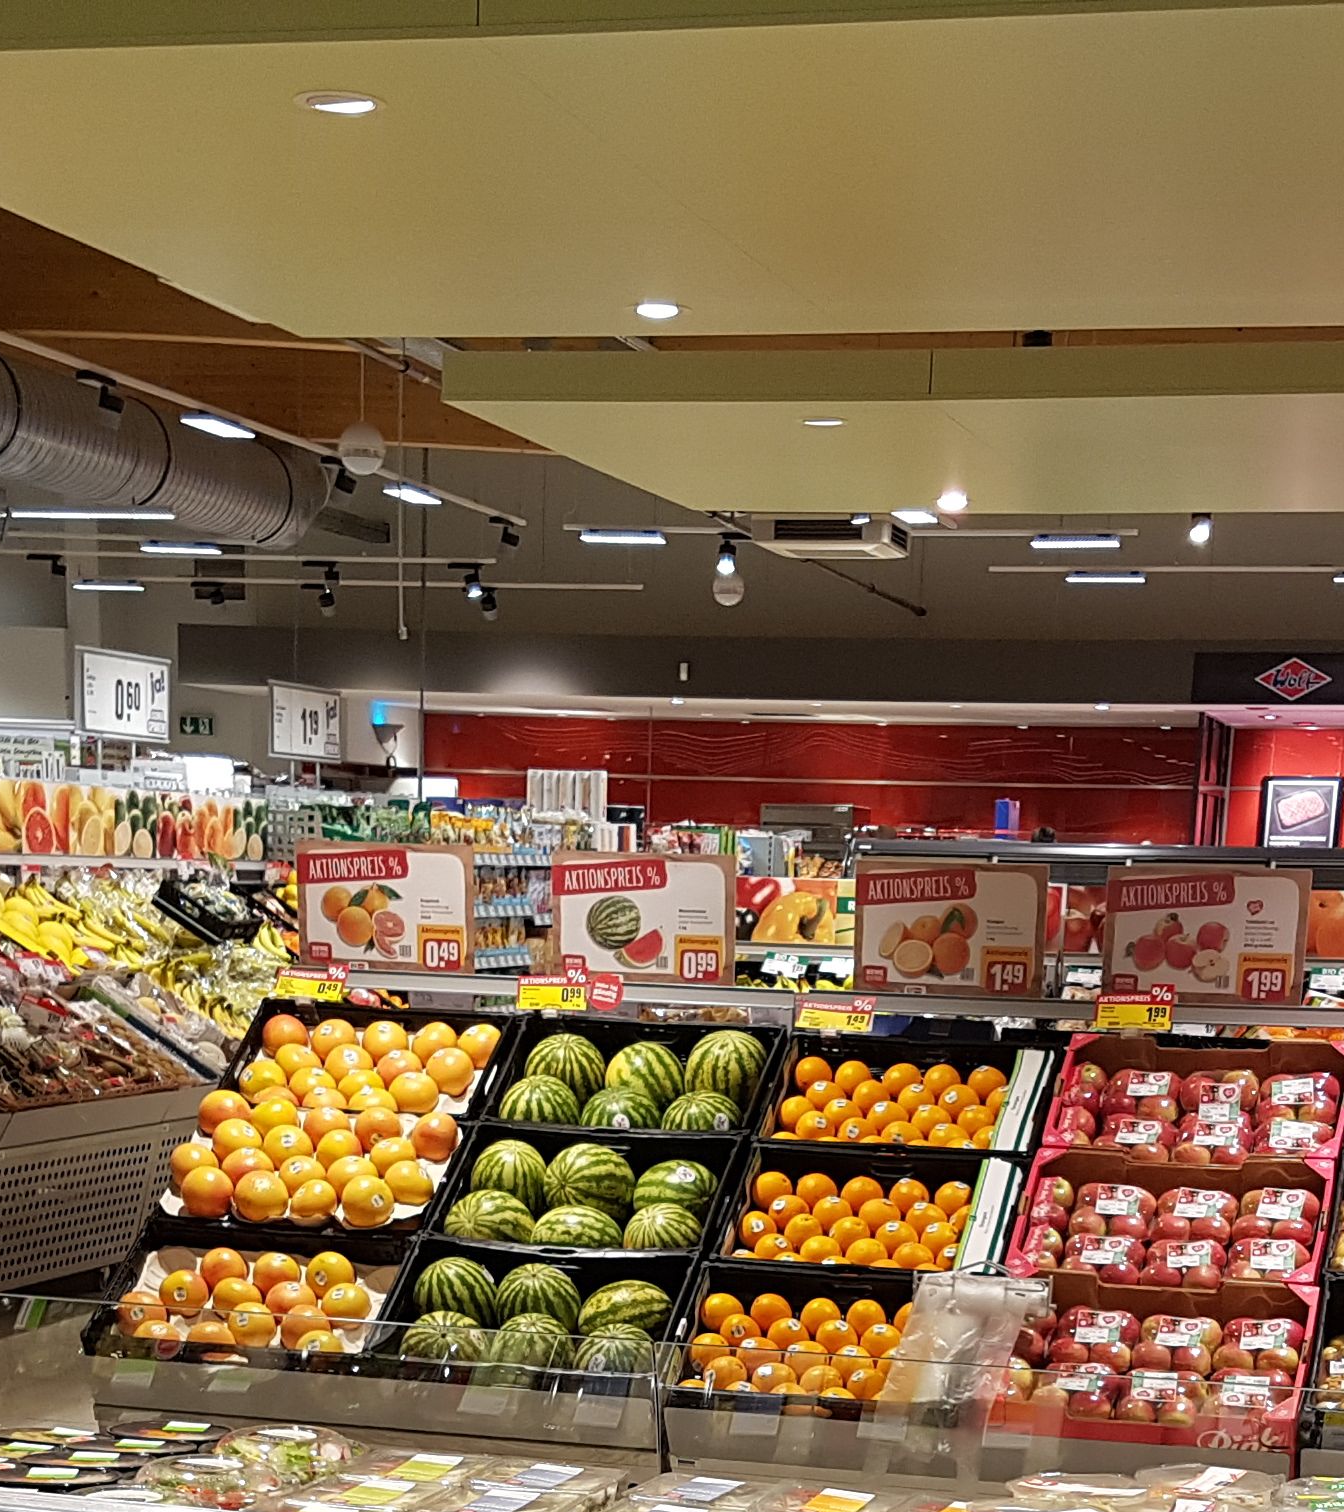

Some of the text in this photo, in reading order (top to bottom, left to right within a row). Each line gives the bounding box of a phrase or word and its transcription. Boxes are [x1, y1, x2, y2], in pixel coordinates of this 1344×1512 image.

[1272, 666, 1318, 690] Wolf
[115, 678, 141, 722] 0.60
[301, 708, 318, 745] 1.19
[309, 856, 386, 880] AKTIONSPREIS
[564, 866, 643, 891] AKTIONSPREIS
[868, 875, 951, 901] AKTIONSPREIS
[1120, 881, 1208, 908] AKTIONSPREIS
[426, 941, 459, 968] 0.49
[683, 952, 717, 978] 0.99
[317, 982, 338, 994] 0.49
[990, 963, 1024, 991] 1.49
[1246, 970, 1282, 999] 1.99
[562, 987, 581, 1002] 0.99
[1152, 986, 1172, 1001] %
[846, 1014, 865, 1026] 1.49
[1146, 1007, 1166, 1022] 1.99
